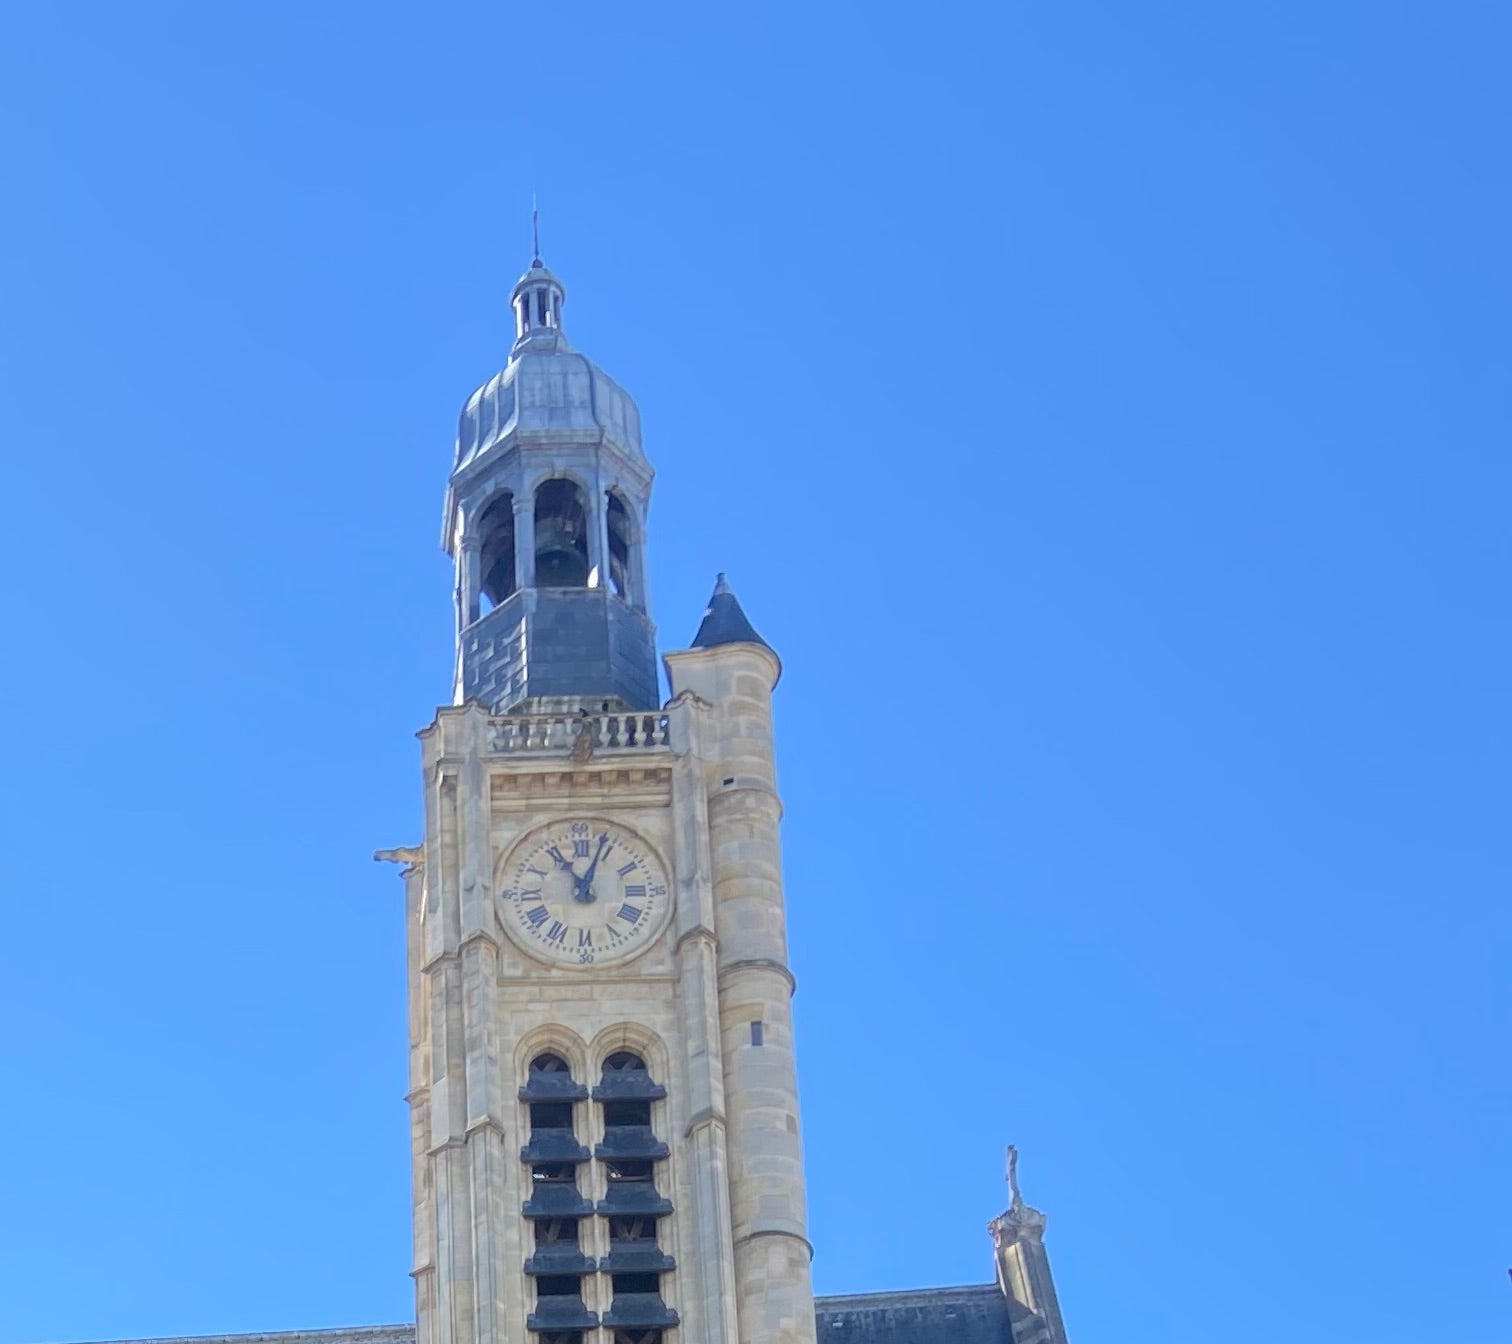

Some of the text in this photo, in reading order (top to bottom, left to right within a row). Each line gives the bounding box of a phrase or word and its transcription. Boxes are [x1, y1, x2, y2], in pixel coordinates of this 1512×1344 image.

[571, 823, 588, 833] 60
[572, 839, 590, 858] XII
[526, 864, 548, 879] X
[616, 861, 638, 880] II
[520, 887, 542, 901] IX
[624, 885, 646, 898] III
[526, 904, 551, 928] VIII
[546, 920, 569, 944] VII
[578, 928, 592, 947] VI
[605, 923, 621, 941] V
[579, 954, 594, 964] 30
